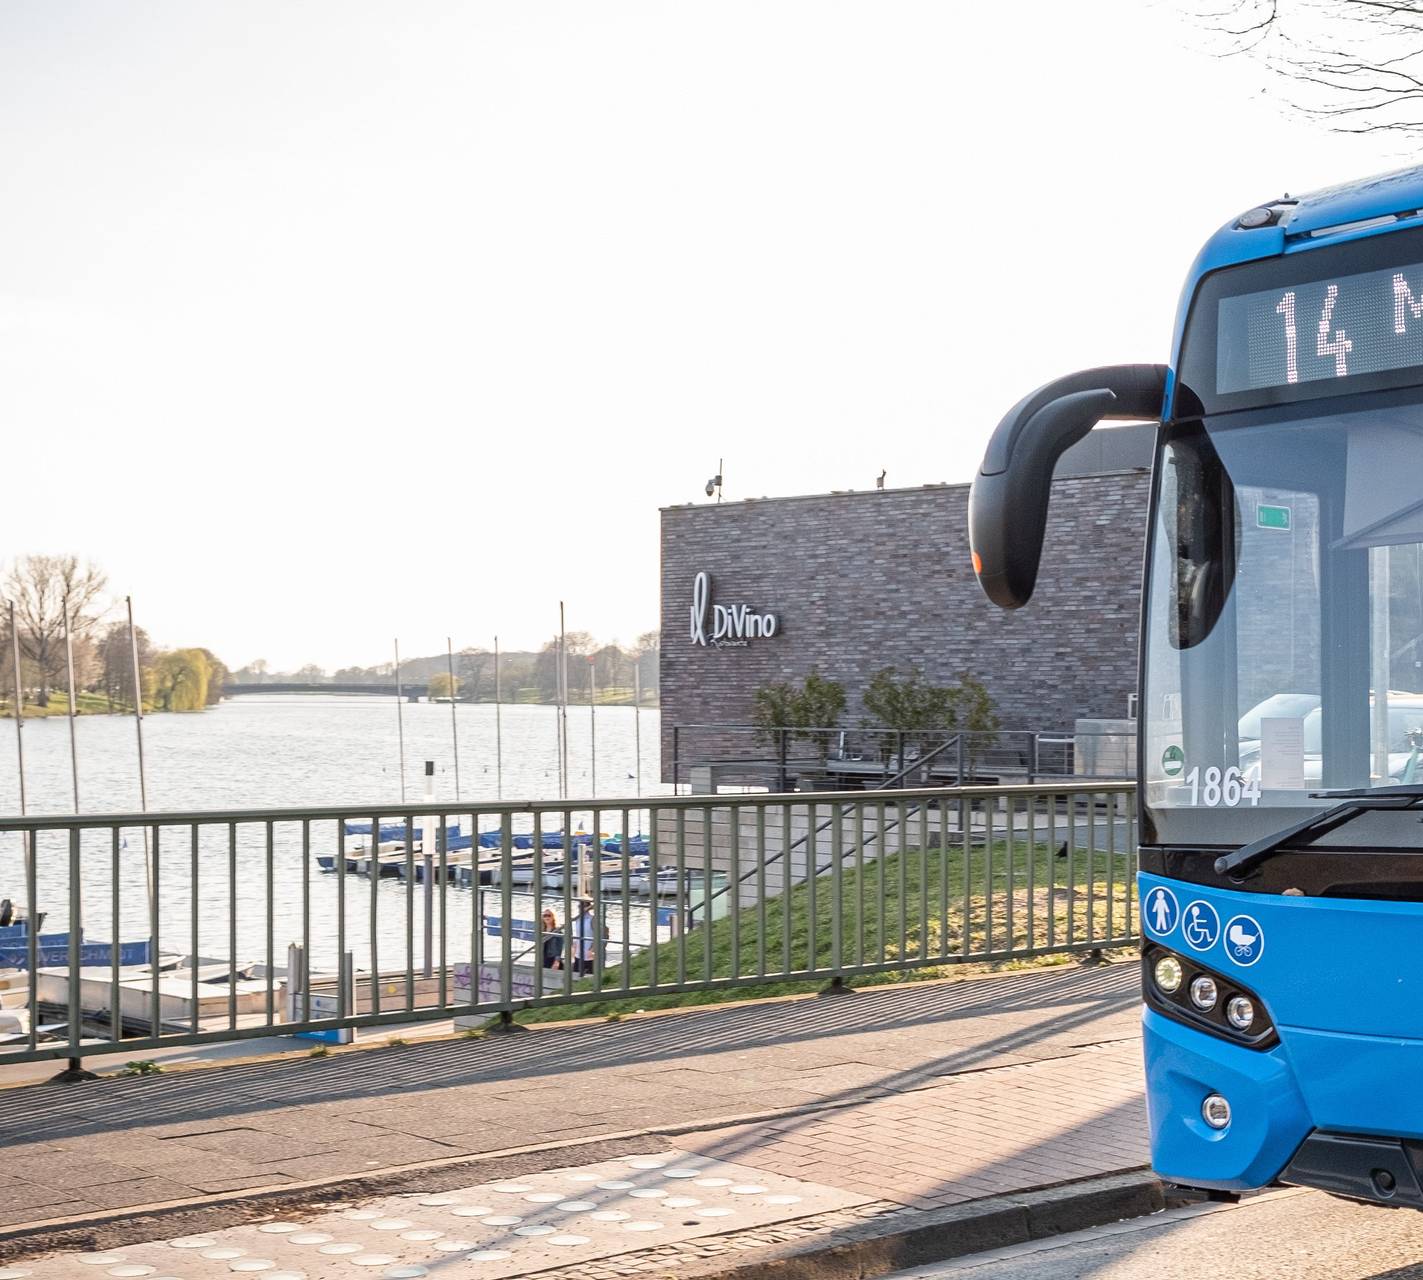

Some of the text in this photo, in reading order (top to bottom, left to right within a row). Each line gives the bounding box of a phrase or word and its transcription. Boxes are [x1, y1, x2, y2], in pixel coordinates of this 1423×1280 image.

[1276, 285, 1352, 383] 14
[713, 604, 776, 639] DiVino
[1185, 766, 1262, 807] 1864
